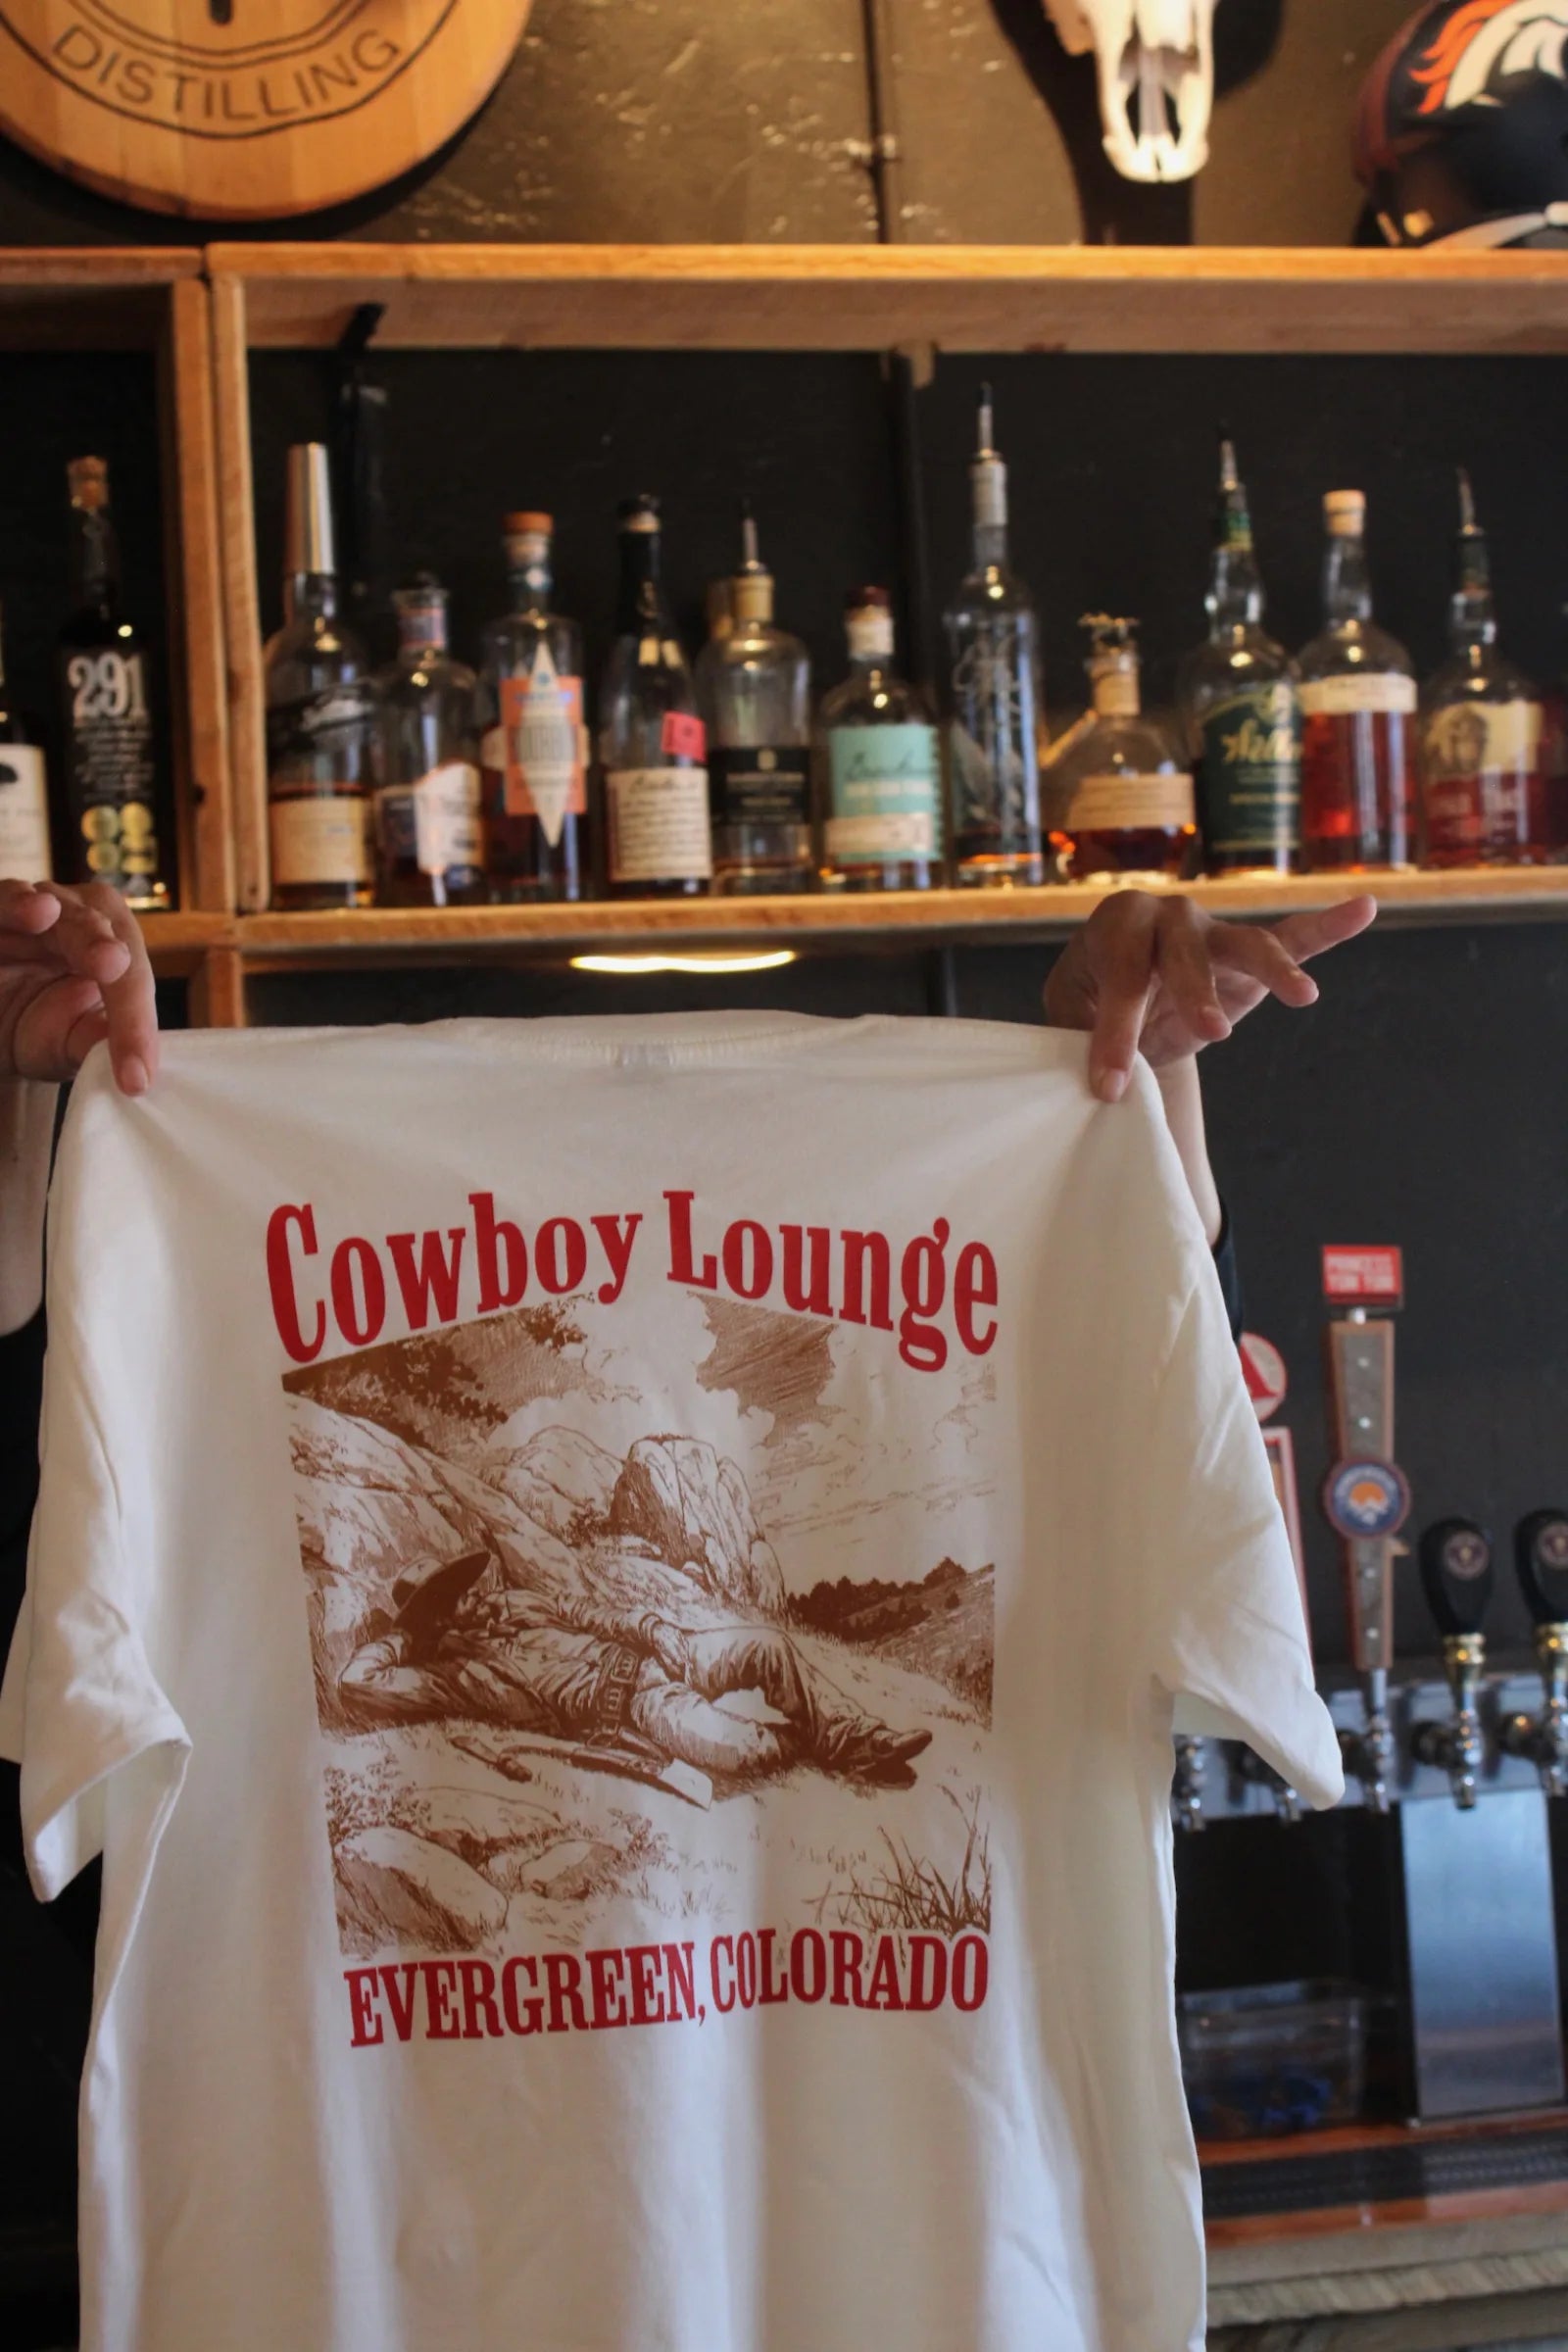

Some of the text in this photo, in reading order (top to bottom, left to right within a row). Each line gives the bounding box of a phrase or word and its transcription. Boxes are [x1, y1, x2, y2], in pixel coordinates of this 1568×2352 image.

[53, 24, 399, 122] DISTILLING
[68, 651, 146, 724] 291
[267, 1191, 998, 1372] Cowboy Lounge
[344, 1928, 989, 2046] EVERGREEN, COLORADO
